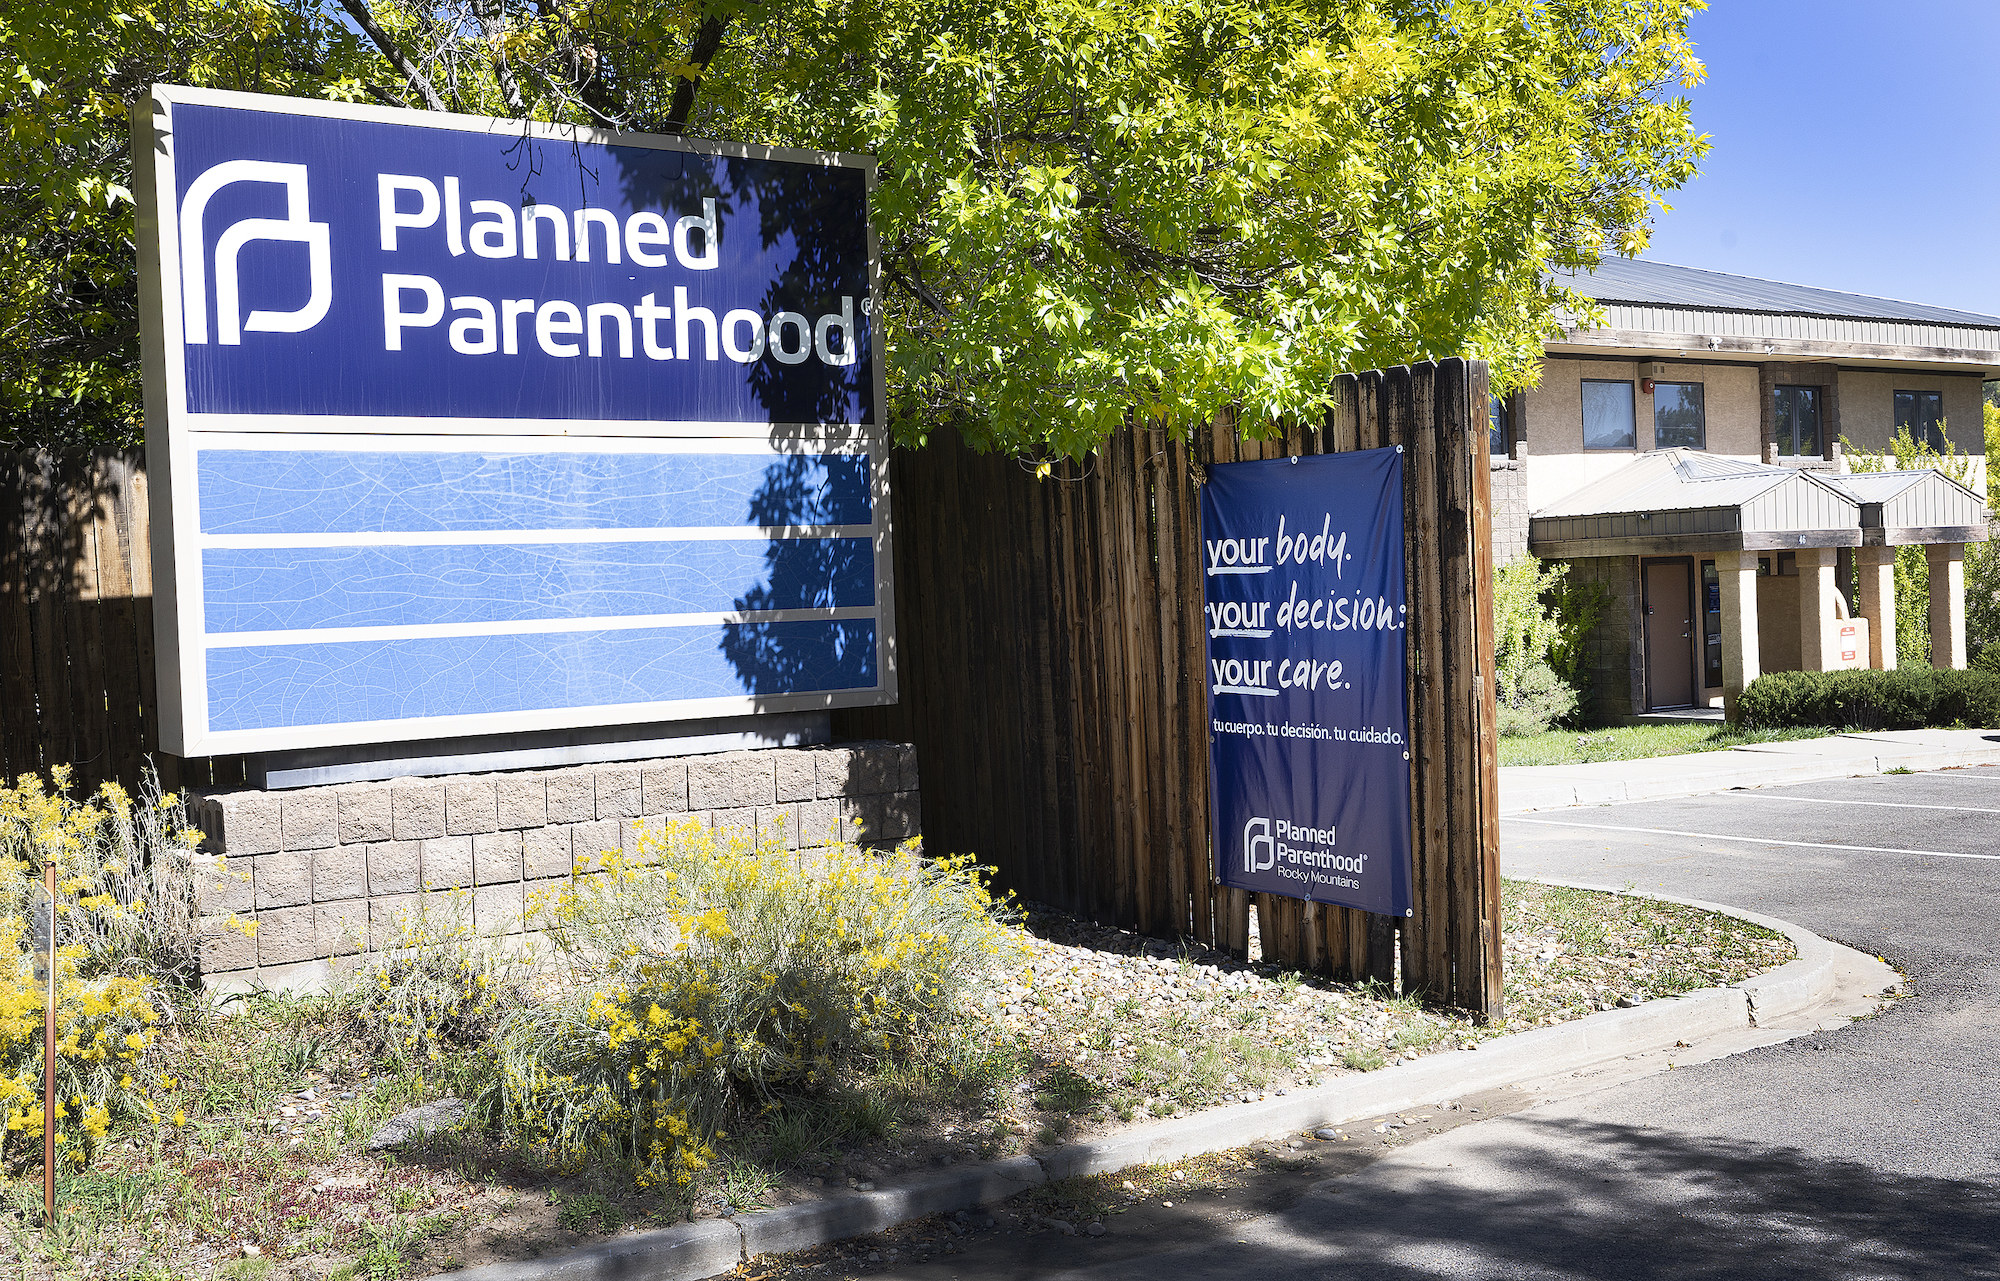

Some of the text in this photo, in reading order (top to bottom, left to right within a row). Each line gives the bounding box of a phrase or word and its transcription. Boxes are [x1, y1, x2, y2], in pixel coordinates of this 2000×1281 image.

[377, 173, 719, 270] Planned
[1206, 512, 1351, 579] your body.
[1209, 580, 1405, 637] your decision.
[1211, 658, 1351, 696] your care.
[1213, 718, 1405, 745] tu cuerpo. tu decisión. tu cuidado.
[1275, 819, 1336, 846] Planned
[1277, 865, 1360, 890] Rocky Mountains
